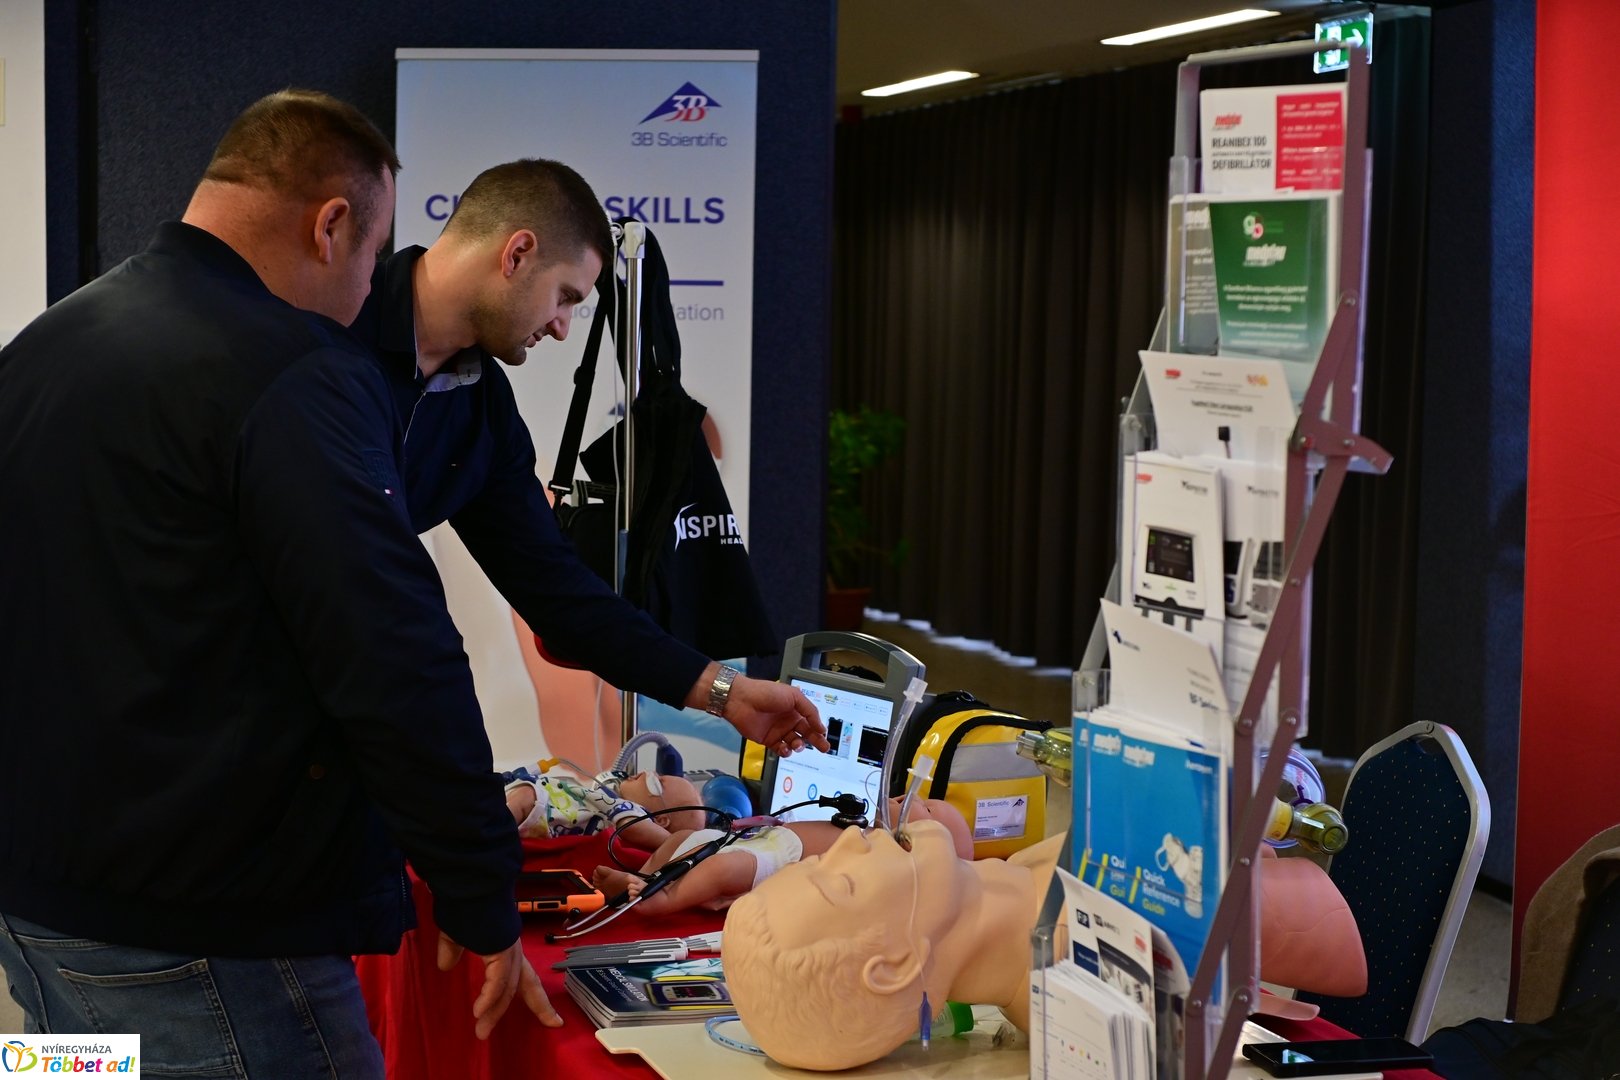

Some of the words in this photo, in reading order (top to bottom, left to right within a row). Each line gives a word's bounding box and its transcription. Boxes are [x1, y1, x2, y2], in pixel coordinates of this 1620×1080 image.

[631, 132, 654, 147] 3B
[657, 131, 728, 147] Scientific
[604, 196, 725, 224] SKILLS
[674, 303, 724, 321] ation
